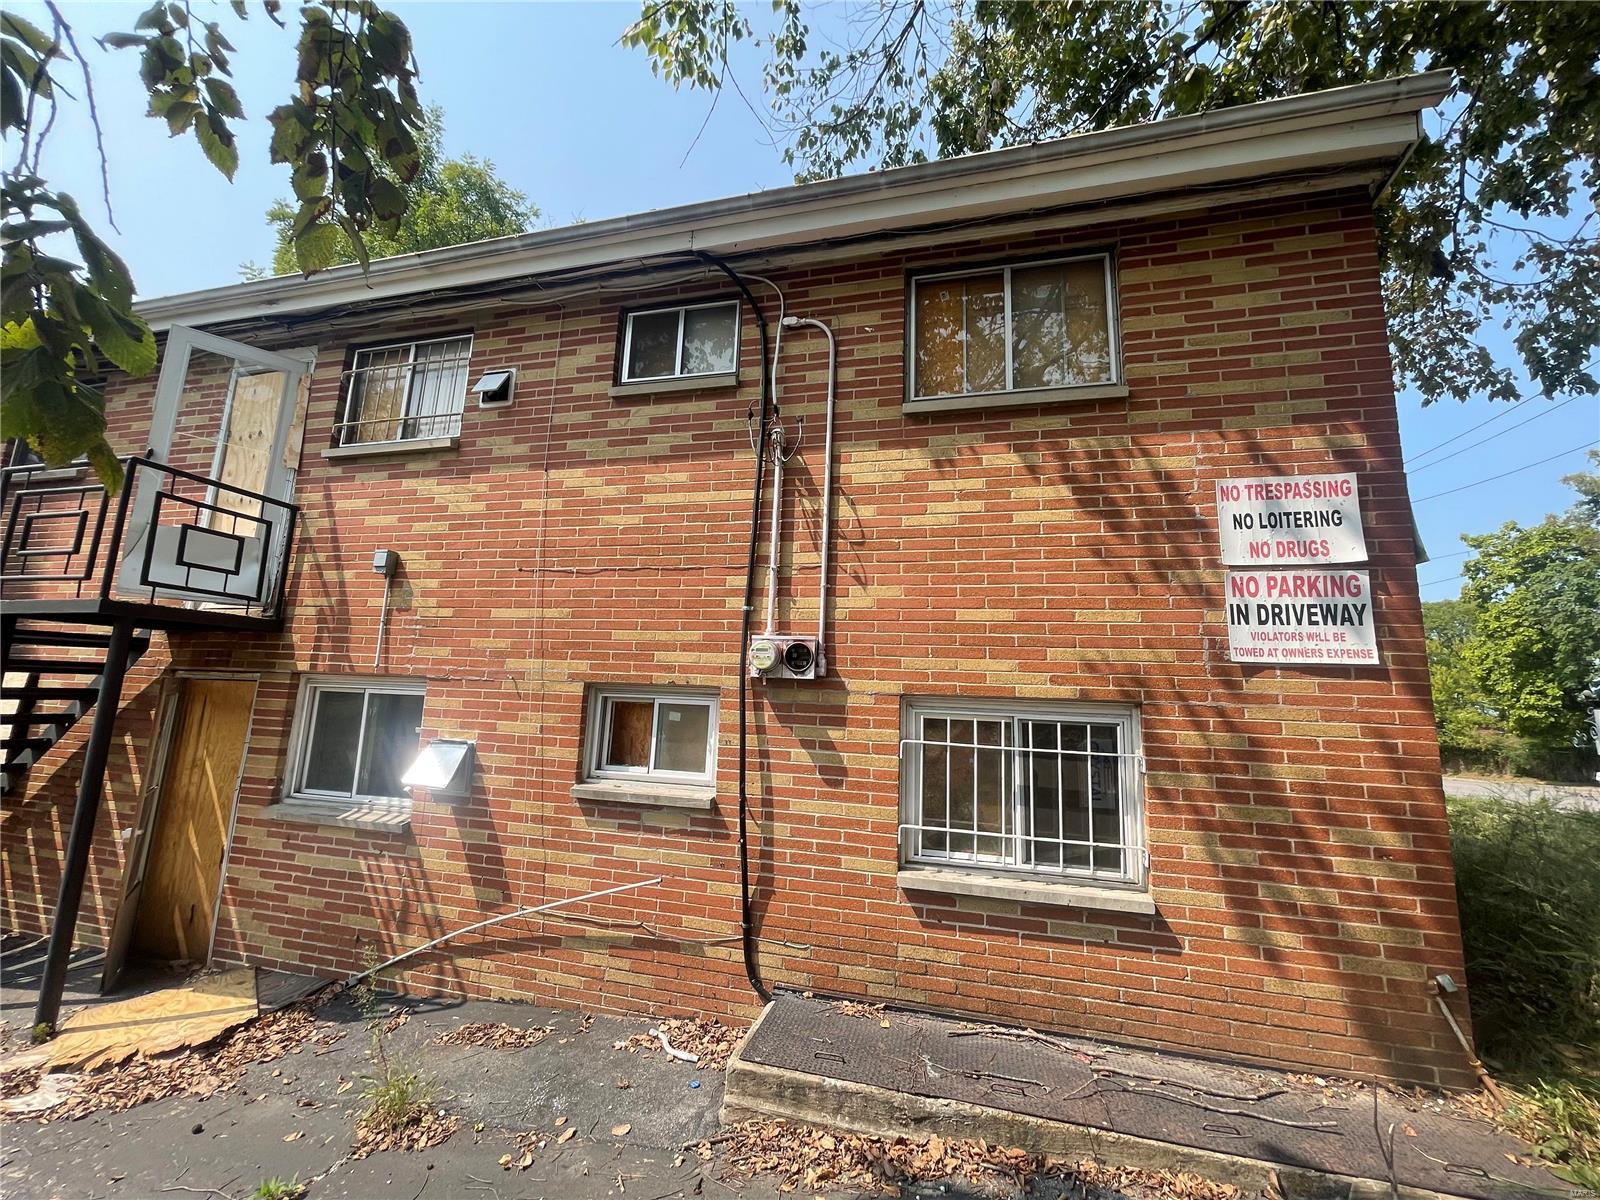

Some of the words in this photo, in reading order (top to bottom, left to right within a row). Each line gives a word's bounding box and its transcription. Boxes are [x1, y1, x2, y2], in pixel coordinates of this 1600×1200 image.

[1220, 485, 1240, 501] NO
[1244, 479, 1352, 500] TRESPASSING
[1232, 513, 1254, 530] NO
[1259, 510, 1343, 529] LOITERING
[1249, 541, 1271, 558] NO
[1276, 540, 1330, 558] DRUGS
[1231, 576, 1259, 598] NO
[1266, 575, 1362, 598] PARKING
[1229, 603, 1250, 626] IN
[1256, 603, 1367, 626] DRIVEWAY
[1250, 632, 1304, 642] VIOLATORS
[1306, 632, 1330, 642] WILL
[1333, 632, 1346, 642] BE
[1233, 647, 1265, 658] TOWED
[1267, 648, 1279, 658] AT
[1281, 648, 1324, 659] OWNERS
[1327, 649, 1374, 659] EXPENSE
